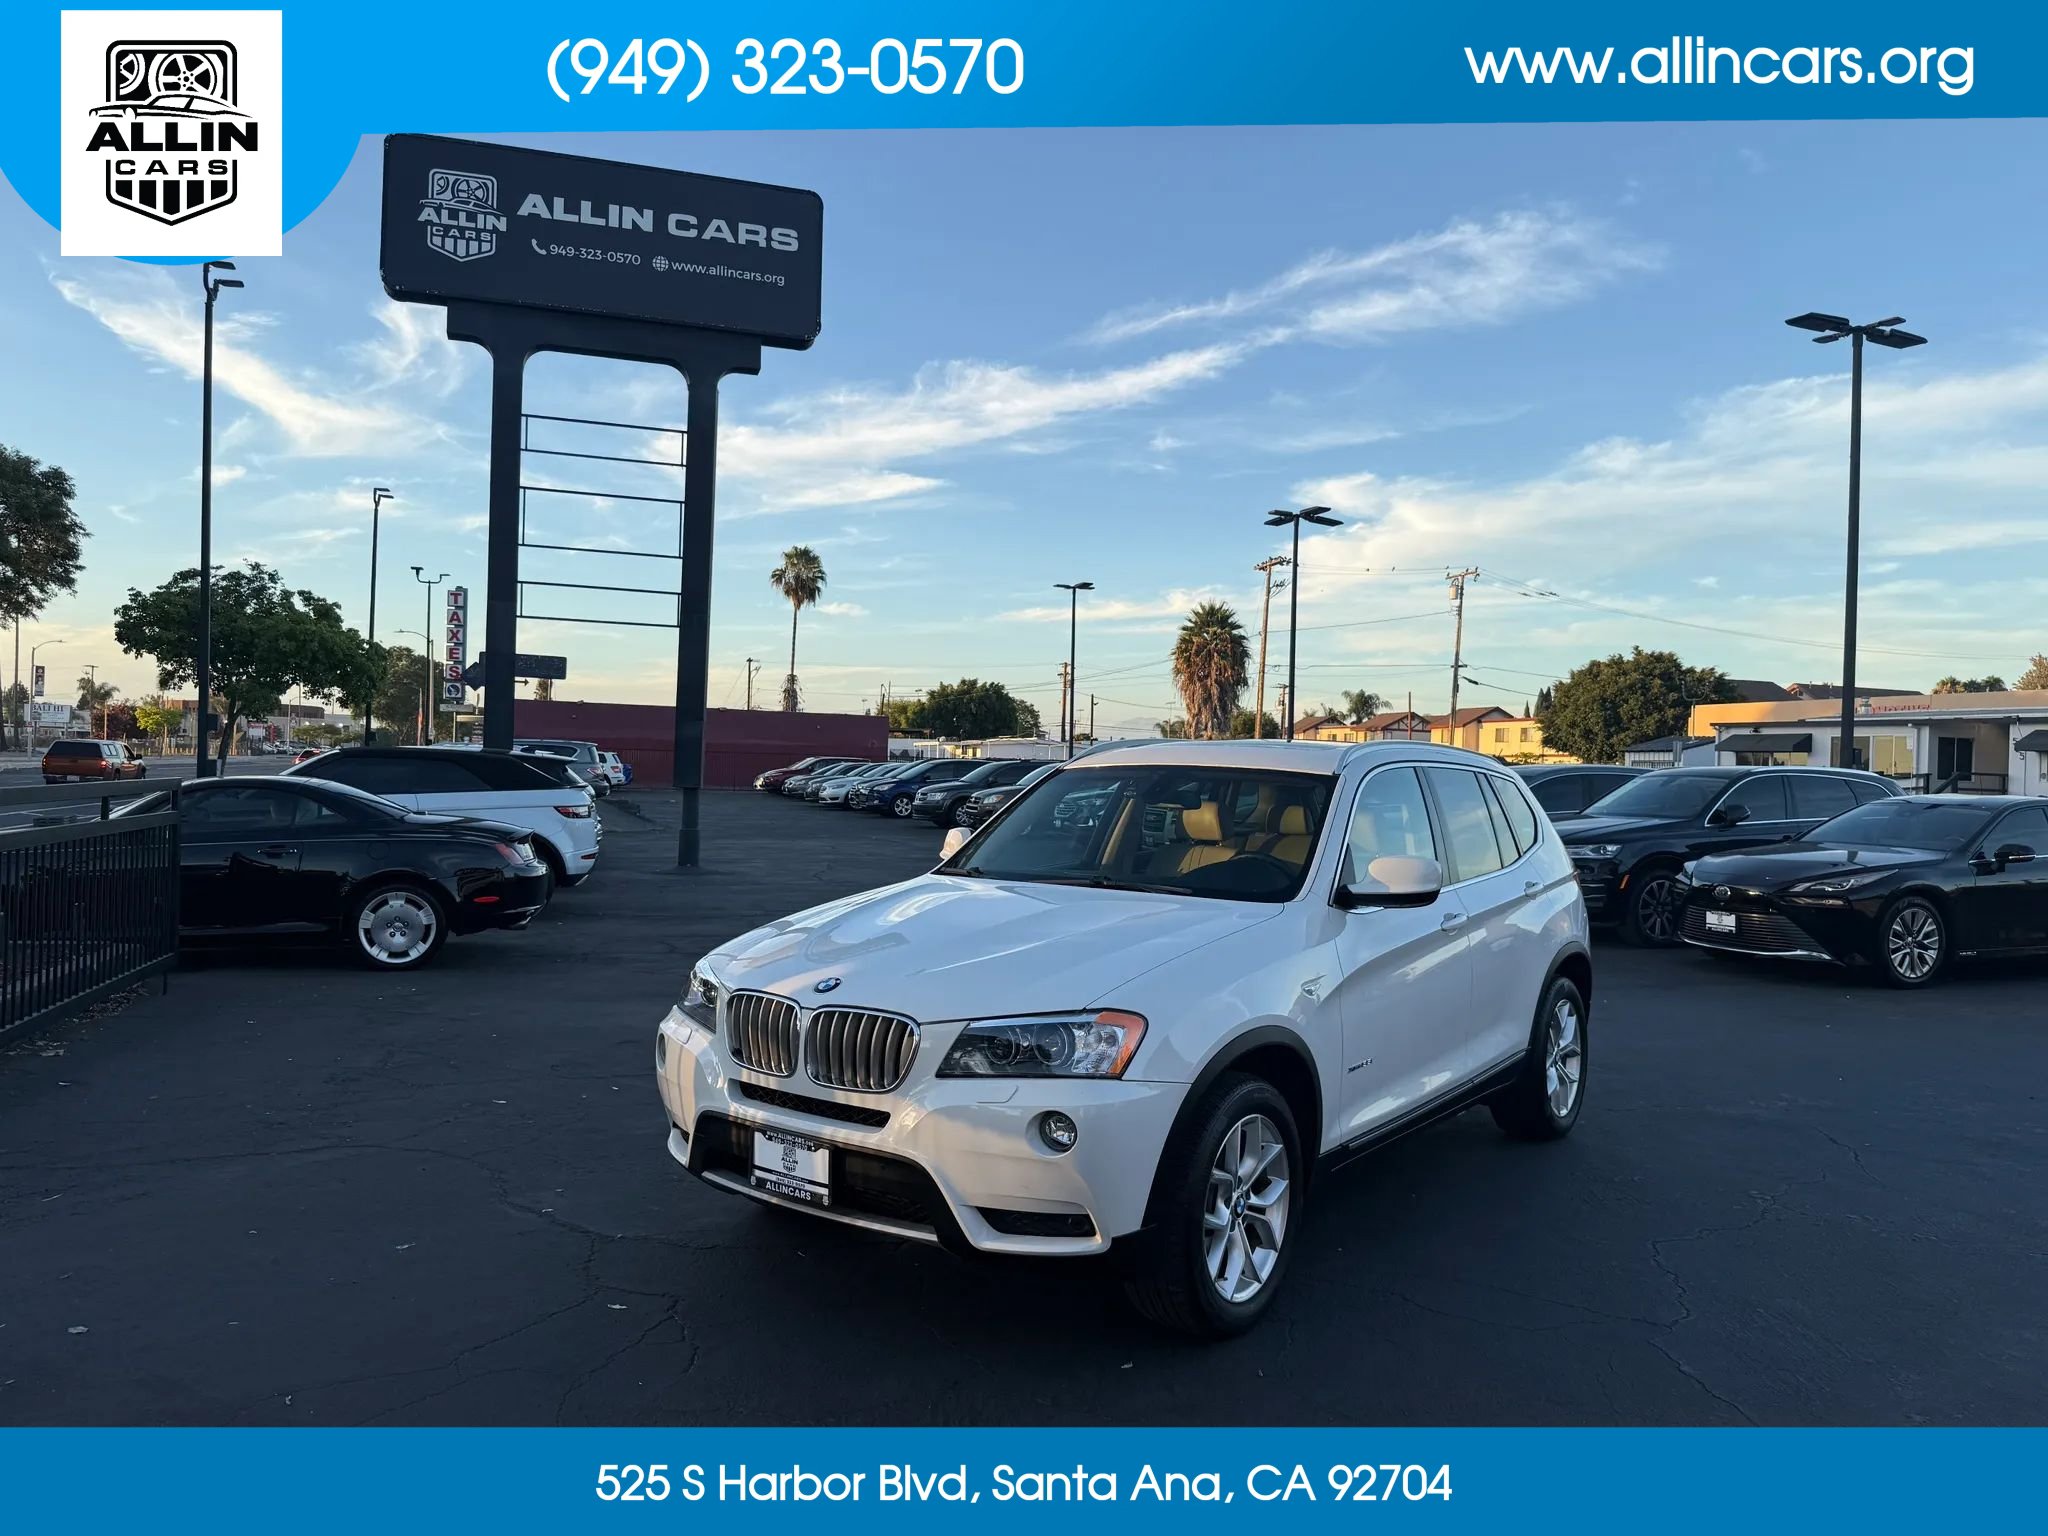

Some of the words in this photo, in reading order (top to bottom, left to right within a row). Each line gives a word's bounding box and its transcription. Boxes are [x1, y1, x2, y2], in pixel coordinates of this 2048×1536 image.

[417, 207, 507, 232] ALLIN
[516, 193, 653, 232] ALLIN
[667, 213, 799, 251] CARS
[432, 226, 491, 241] CARS
[549, 244, 641, 265] 949-323-0570
[671, 261, 785, 287] www.allincars.org
[449, 592, 463, 680] TAXES
[765, 1181, 812, 1201] ALLINCARS
